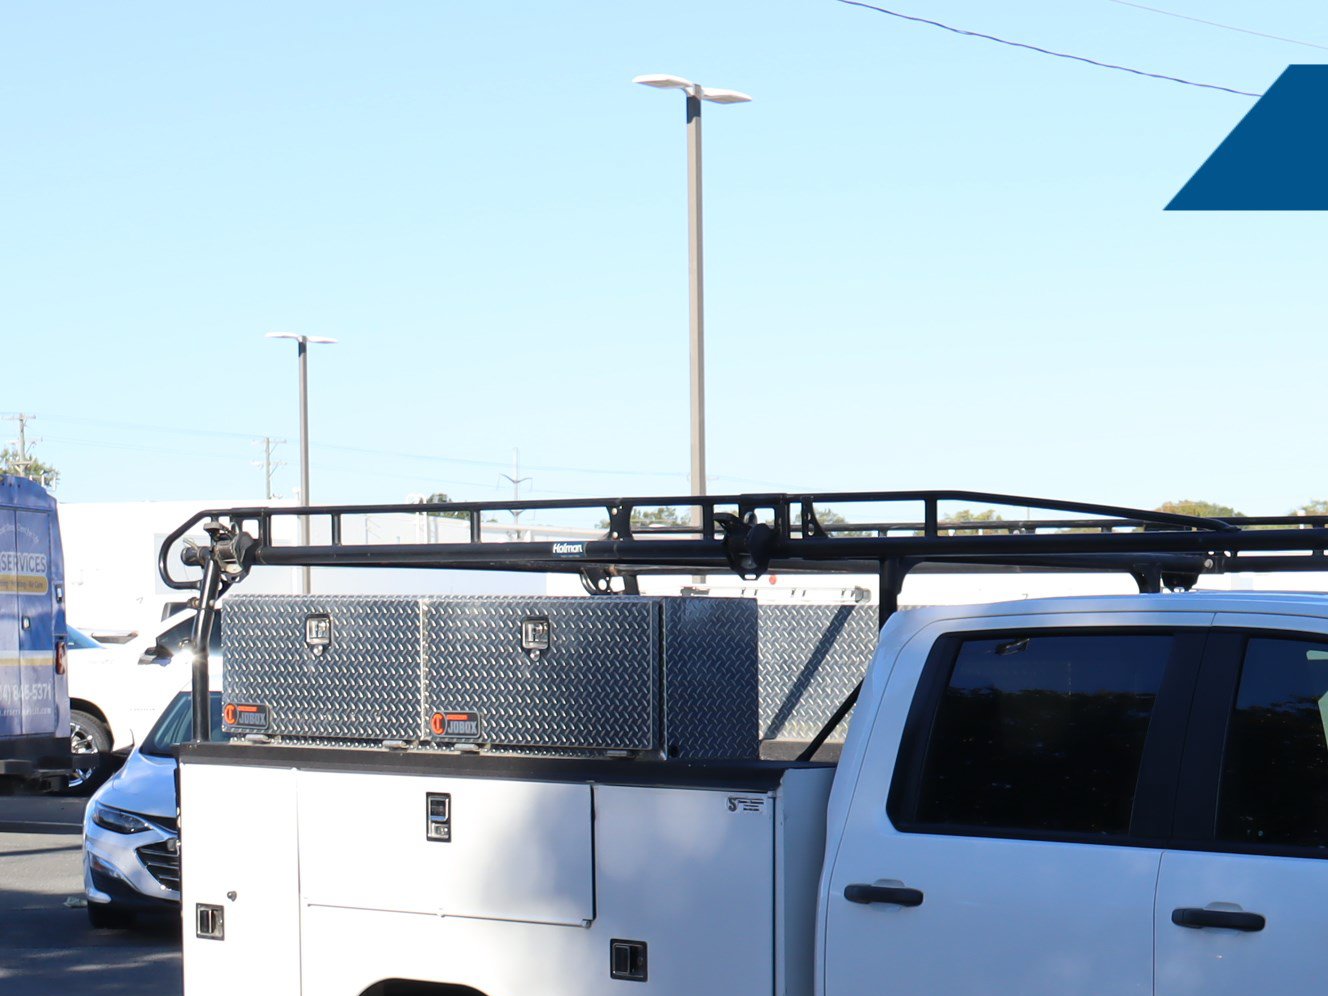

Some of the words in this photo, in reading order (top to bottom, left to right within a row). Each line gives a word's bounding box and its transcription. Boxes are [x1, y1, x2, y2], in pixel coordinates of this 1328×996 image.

[552, 542, 583, 554] Holman
[239, 712, 266, 725] JOBOX
[447, 720, 478, 734] JOBOX
